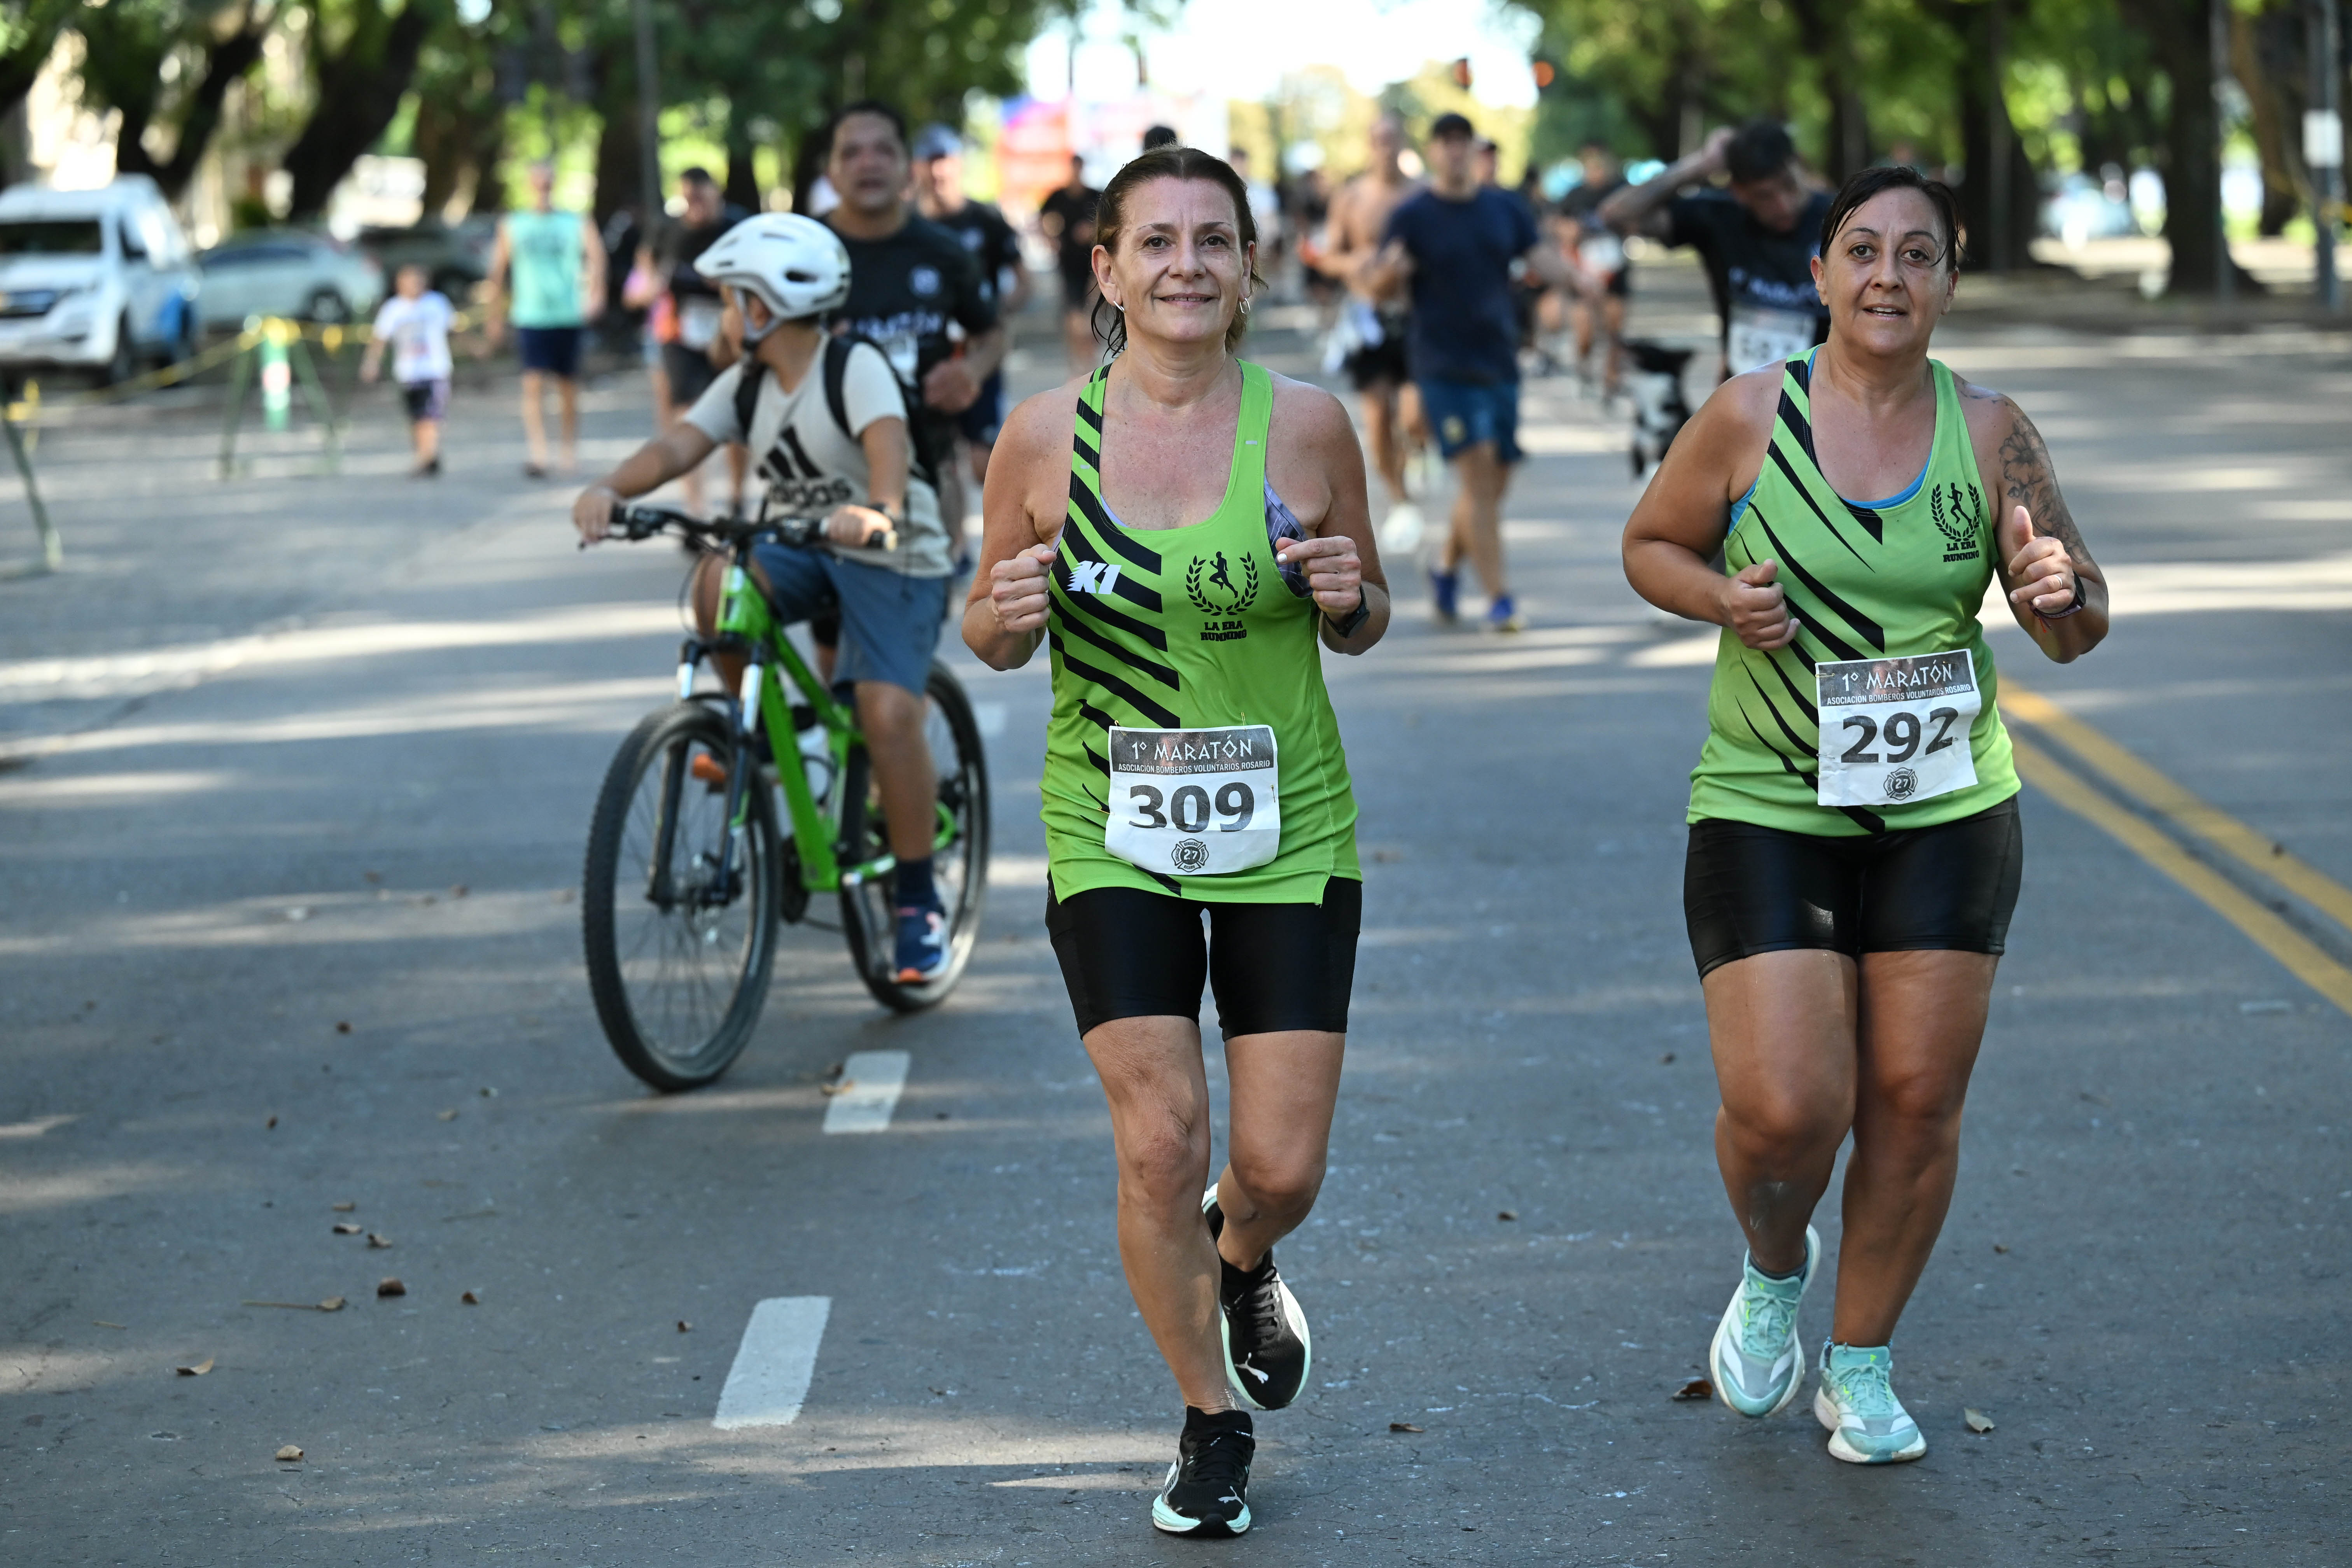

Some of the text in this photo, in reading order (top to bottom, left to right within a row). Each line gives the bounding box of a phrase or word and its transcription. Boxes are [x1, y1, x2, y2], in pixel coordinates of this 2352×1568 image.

[1946, 541, 1976, 551] LA ERA
[1943, 550, 1979, 562] RUNNING
[1066, 560, 1122, 595] K1
[1204, 620, 1243, 631] LA ERA
[1200, 629, 1247, 642] RUNNING
[1866, 659, 1952, 690] MARATÓN
[1869, 692, 1905, 703] BOMBEROS
[1906, 687, 1944, 700] VOLUNTARIOS
[1944, 683, 1971, 694] ROSARIO
[1841, 707, 1959, 763] 292
[1154, 734, 1252, 761] MARATÓN
[1118, 760, 1270, 774] ASOCIACIÓN BOMBEROS VOLUNTARIOS ROSARIO
[1895, 778, 1908, 789] 27
[1129, 782, 1255, 834] 309
[1183, 849, 1198, 860] 27
